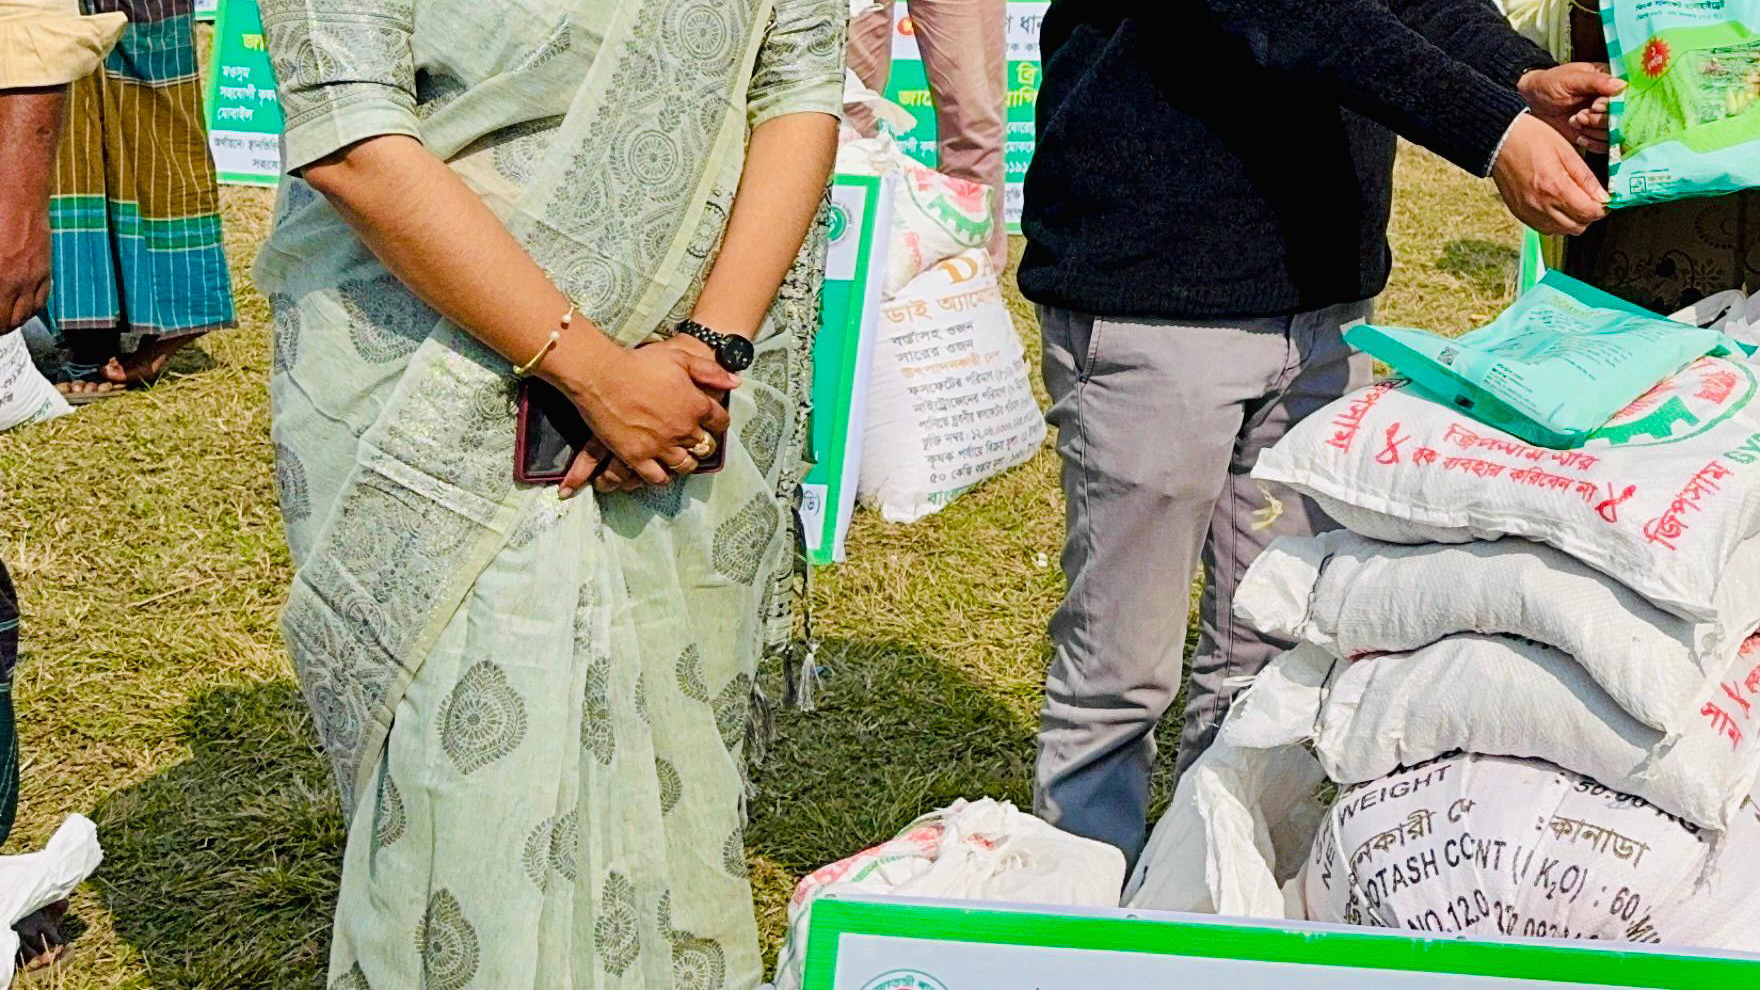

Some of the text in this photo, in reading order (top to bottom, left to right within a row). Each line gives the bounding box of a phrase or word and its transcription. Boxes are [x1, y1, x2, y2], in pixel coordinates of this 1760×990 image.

[1338, 765, 1452, 826] WEIGHT
[1549, 815, 1652, 868] কানাডা
[1366, 848, 1440, 908] OTASH
